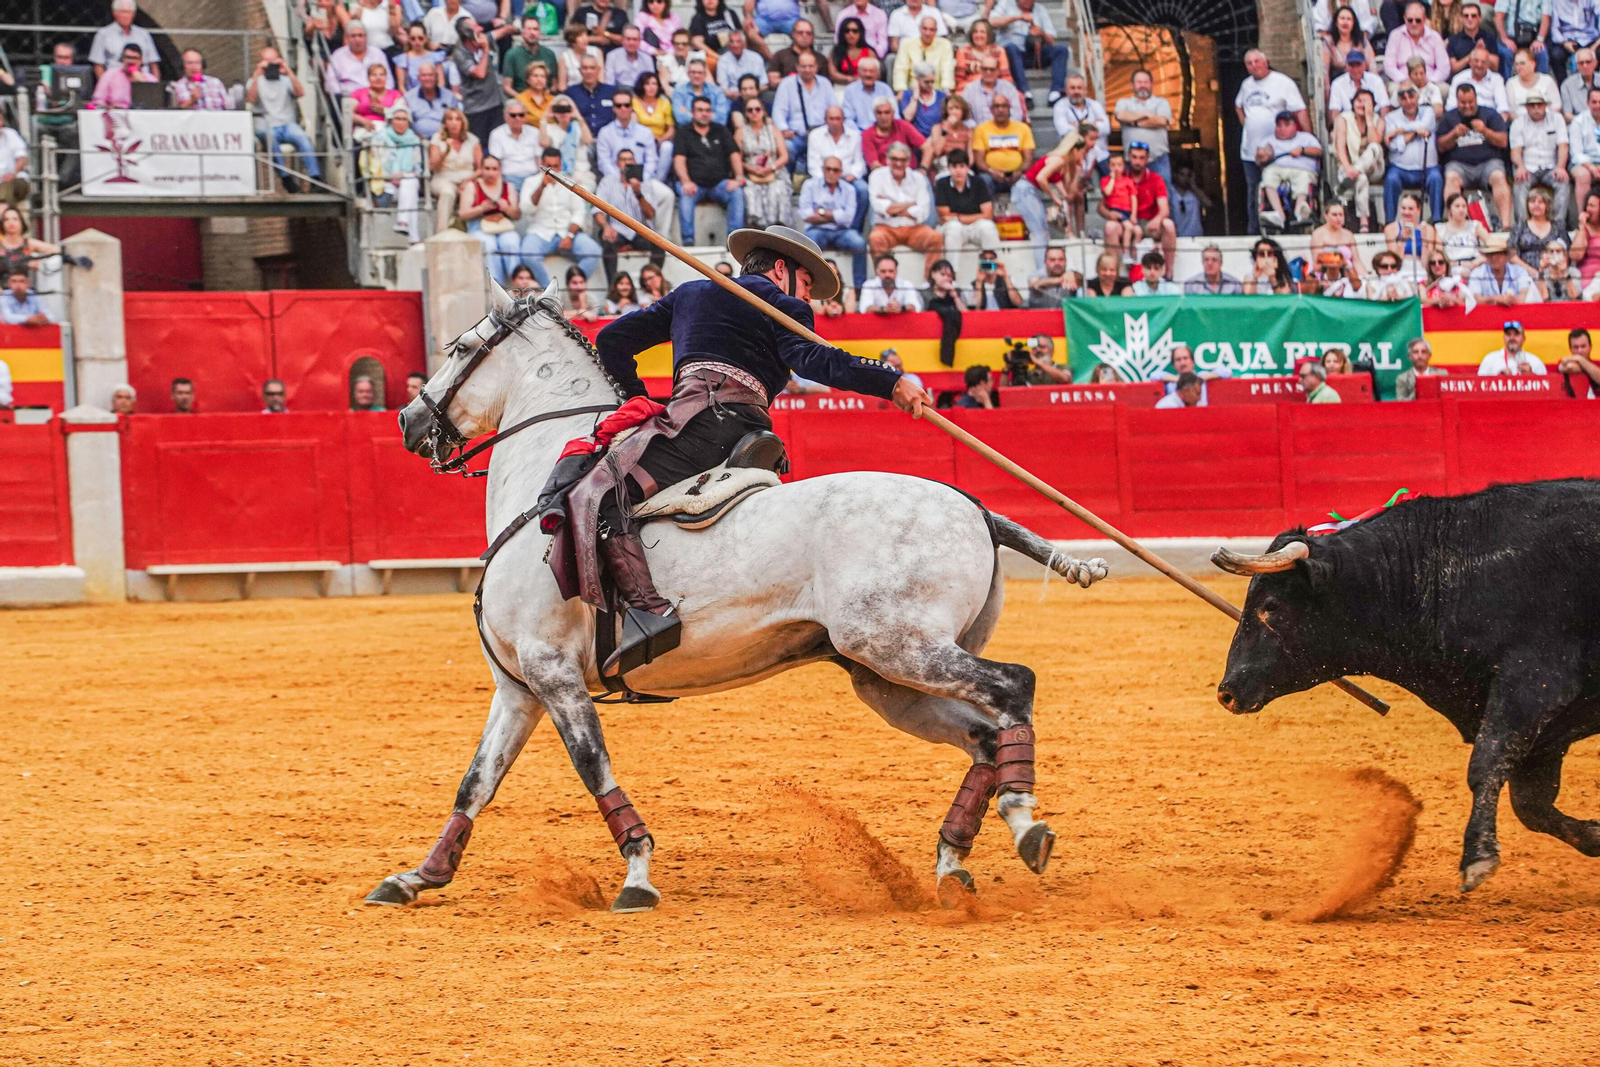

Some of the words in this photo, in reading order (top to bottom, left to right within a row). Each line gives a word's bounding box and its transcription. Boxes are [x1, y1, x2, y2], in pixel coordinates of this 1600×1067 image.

[150, 133, 220, 150] GRANADA
[223, 133, 242, 150] FM
[1194, 341, 1277, 372] CAJA
[1250, 382, 1305, 396] PRENS
[1480, 378, 1550, 392] CALLEJON
[774, 398, 806, 410] ICIO
[818, 397, 865, 410] PLAZA
[1050, 390, 1116, 404] PRENSA
